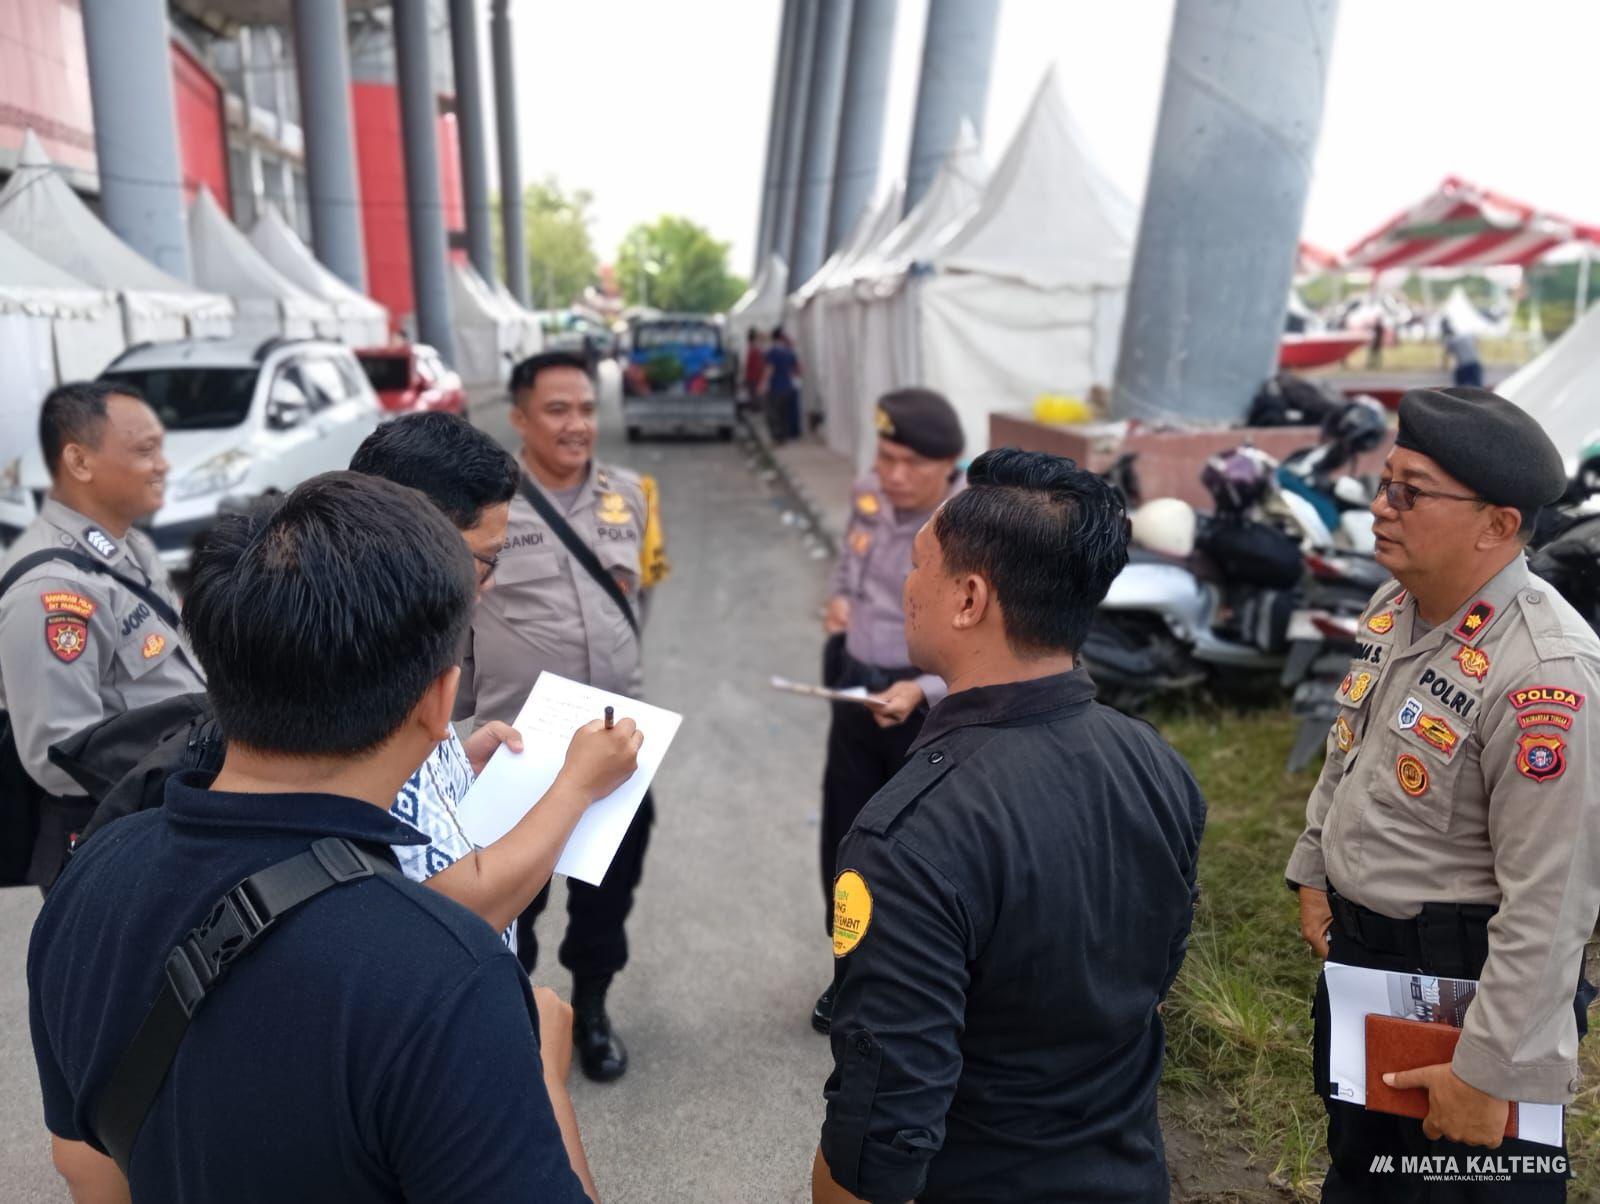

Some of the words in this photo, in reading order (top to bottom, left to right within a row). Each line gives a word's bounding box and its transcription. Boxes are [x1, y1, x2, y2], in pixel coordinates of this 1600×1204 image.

[121, 602, 150, 636] JOKO
[1419, 668, 1475, 718] POLRI
[1516, 689, 1576, 706] POLDA
